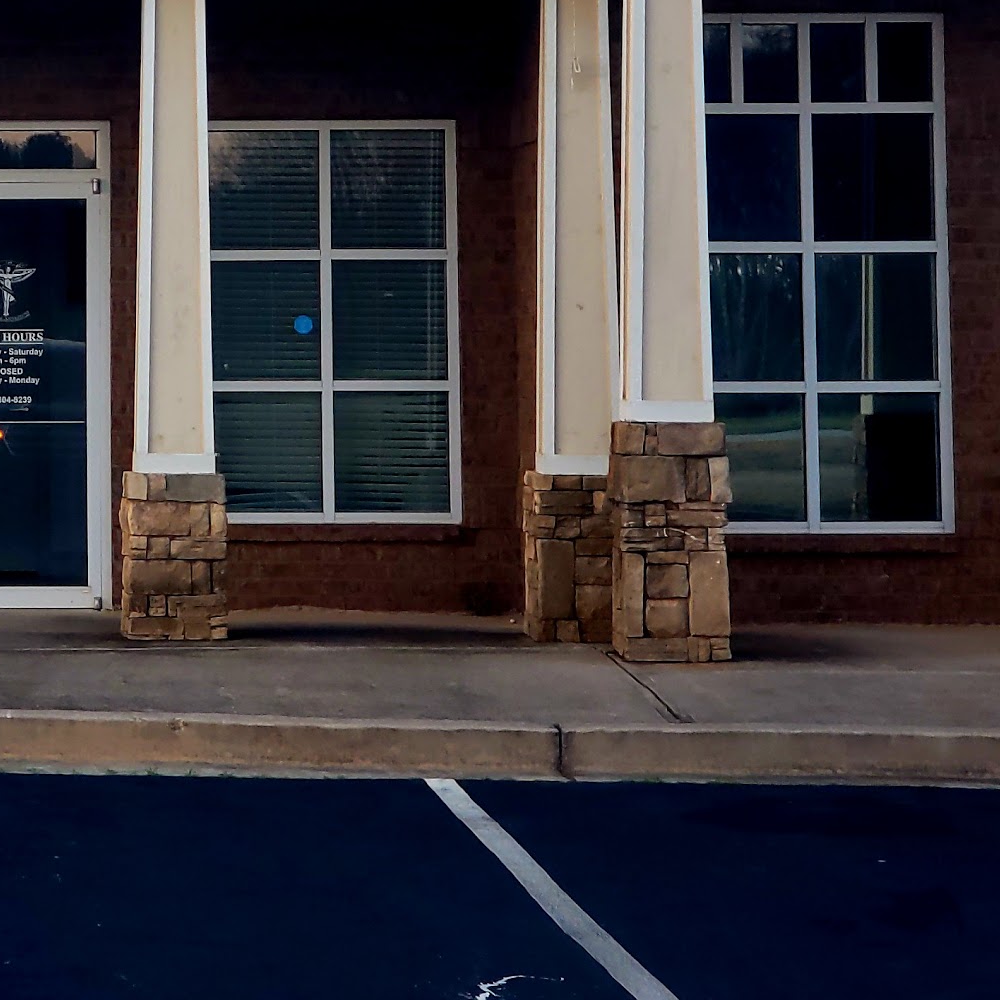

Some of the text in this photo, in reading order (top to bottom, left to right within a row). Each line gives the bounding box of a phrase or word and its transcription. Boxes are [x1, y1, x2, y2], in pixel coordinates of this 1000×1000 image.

[1, 332, 44, 342] HOURS
[8, 348, 44, 357] Saturday
[8, 376, 41, 385] Monday
